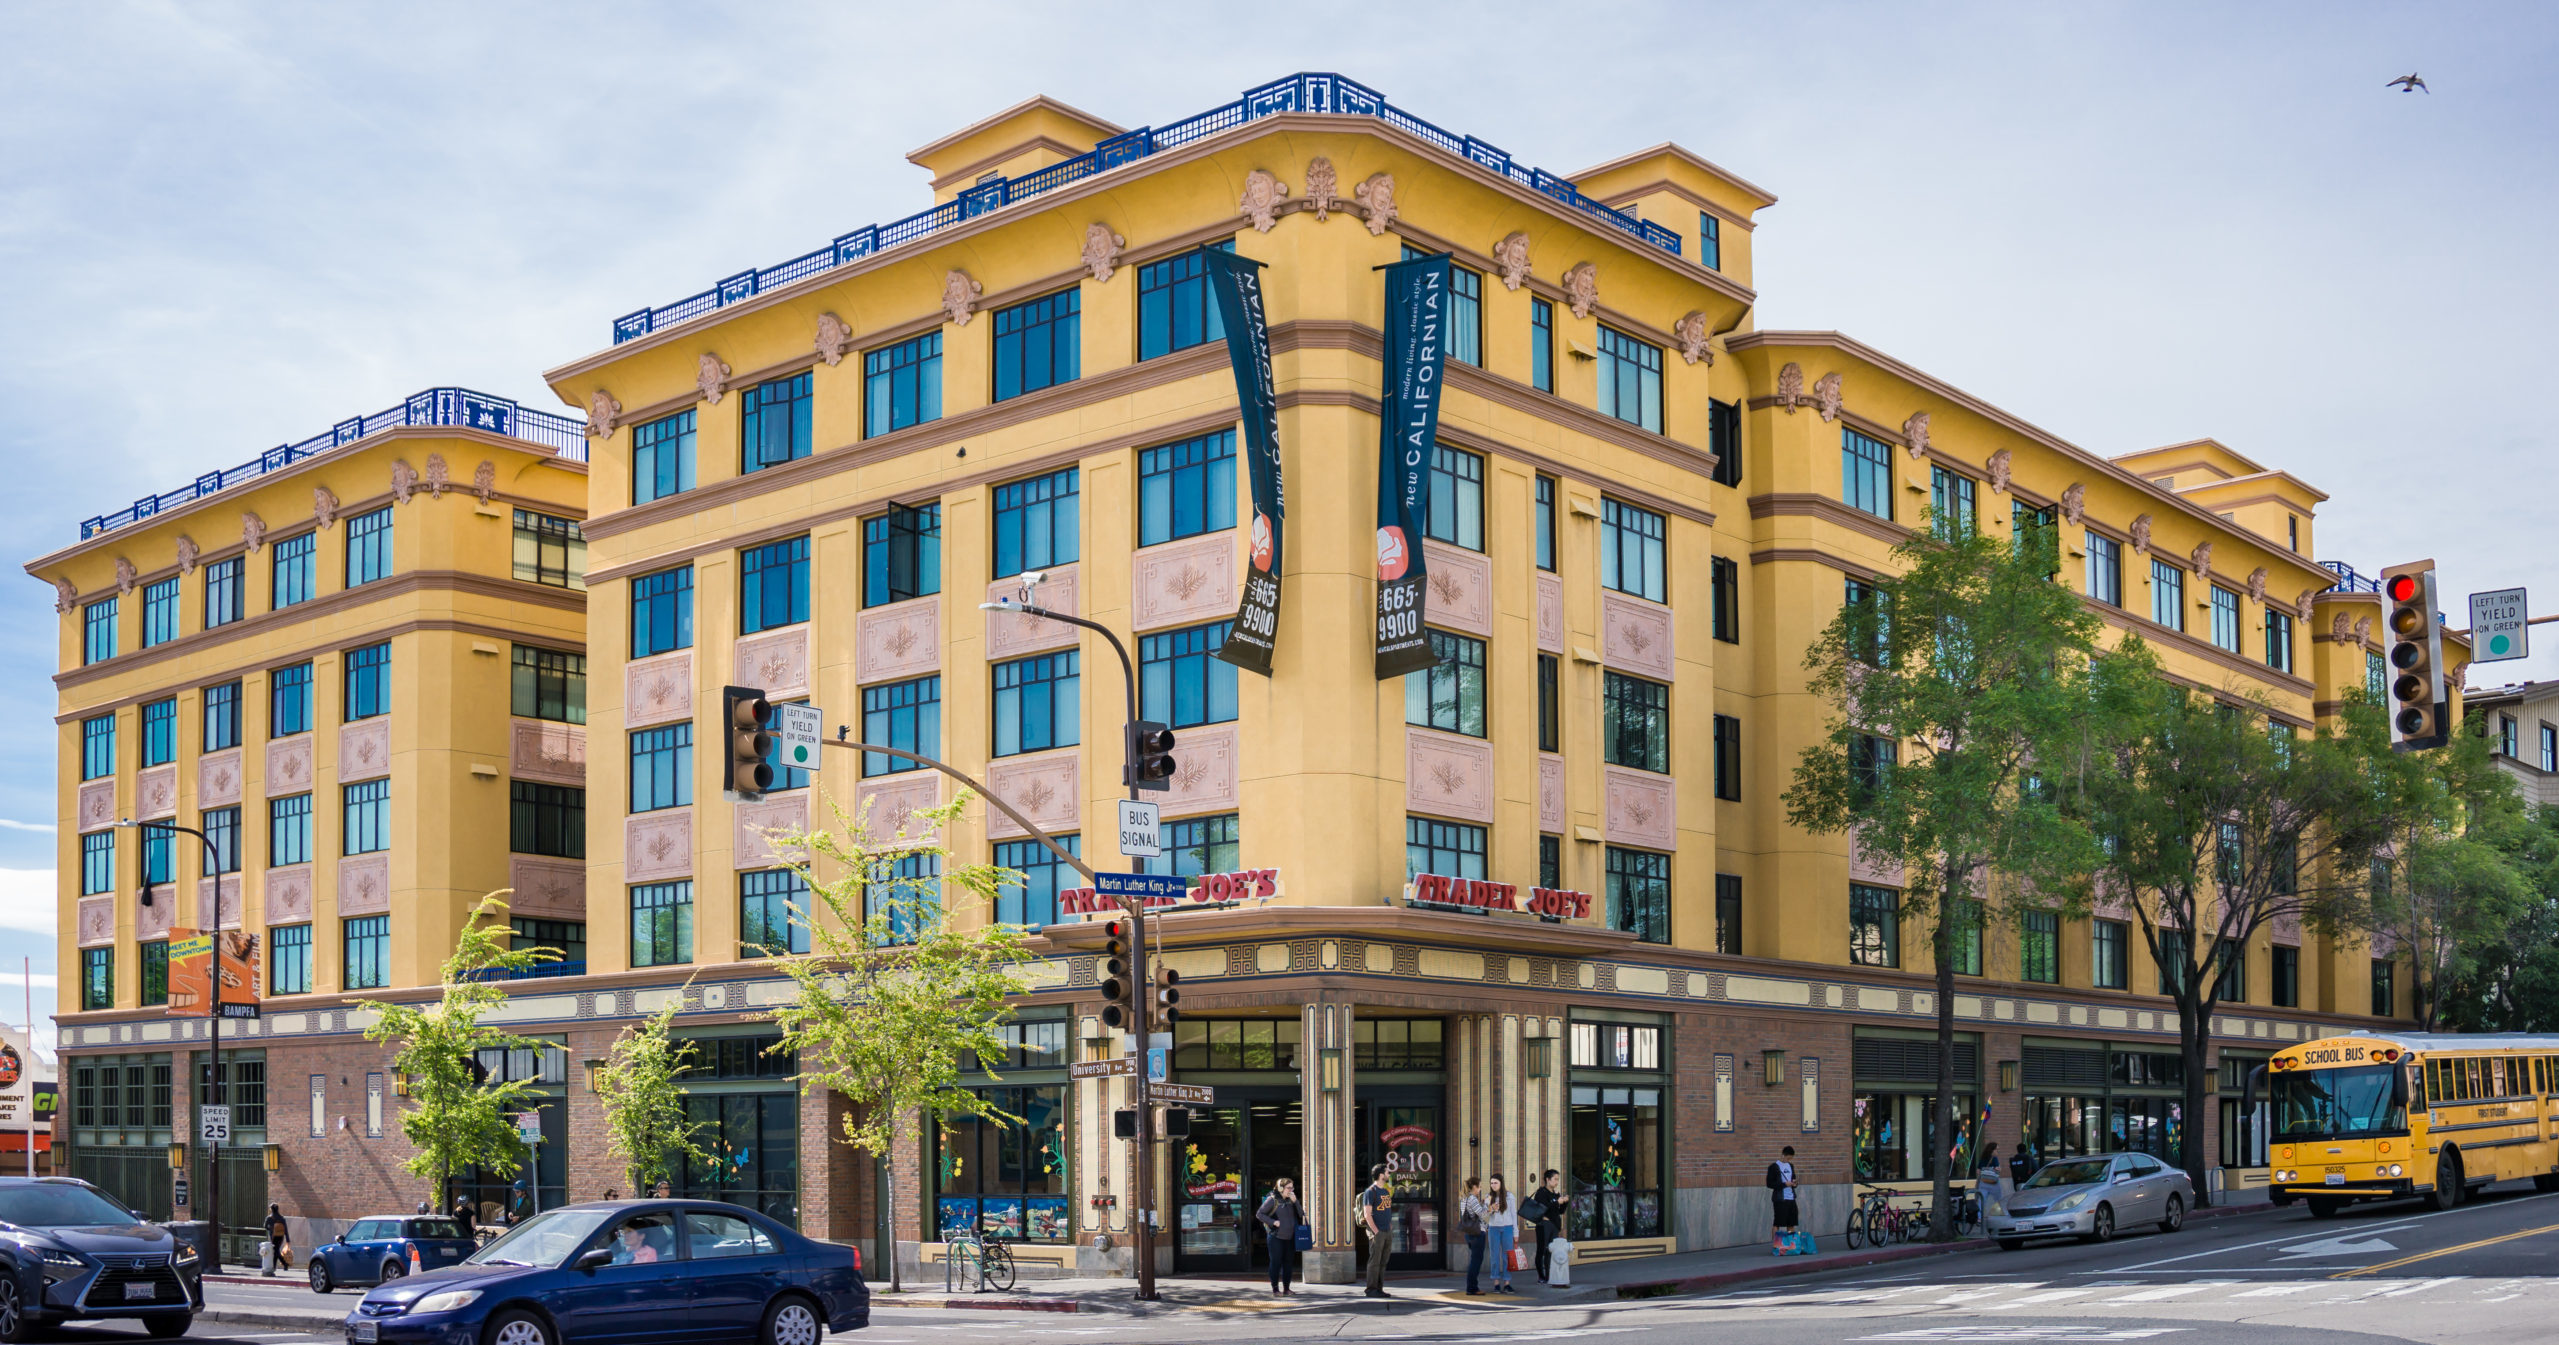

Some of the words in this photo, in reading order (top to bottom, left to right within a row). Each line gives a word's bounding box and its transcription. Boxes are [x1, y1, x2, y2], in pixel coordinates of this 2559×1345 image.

[1406, 271, 1440, 466] CALIFORNIAN
[1402, 367, 1412, 400] modern
[1406, 471, 1418, 508] new
[2475, 597, 2494, 607] LEFT
[2500, 594, 2520, 604] TURN
[1243, 603, 1275, 637] 9900
[2481, 607, 2516, 620] YIELD
[1378, 609, 1417, 641] 9900
[2479, 625, 2489, 633] ON
[2494, 621, 2520, 632] GREEN
[786, 709, 800, 717] LEFT
[803, 711, 817, 720] TURN
[791, 720, 813, 732] YIELD
[786, 732, 795, 740] ON
[797, 734, 816, 744] GREEN
[1129, 811, 1149, 826] BUS
[1122, 831, 1159, 848] SIGNAL
[1099, 877, 1121, 890] Martin
[1124, 879, 1146, 891] Luther
[1148, 880, 1164, 895] King
[1190, 869, 1278, 903] JOE'S
[1414, 873, 1517, 910] TRADER
[1525, 887, 1592, 918] JOE'S
[168, 943, 186, 951] MEET
[170, 945, 212, 959] DOWNTOWN
[252, 933, 260, 960] FILM
[252, 963, 260, 972] &
[252, 975, 260, 999] ART
[224, 1005, 255, 1017] BAMPFA
[2304, 1049, 2341, 1065] SCHOOL
[2345, 1047, 2364, 1062] BUS
[1072, 1063, 1111, 1078] University
[1150, 1085, 1163, 1096] Martin
[1164, 1086, 1177, 1097] Luther
[1178, 1087, 1188, 1101] King
[204, 1125, 227, 1138] 25
[1386, 1151, 1399, 1172] 8
[1409, 1151, 1432, 1172] 10
[1396, 1173, 1418, 1181] DAILY
